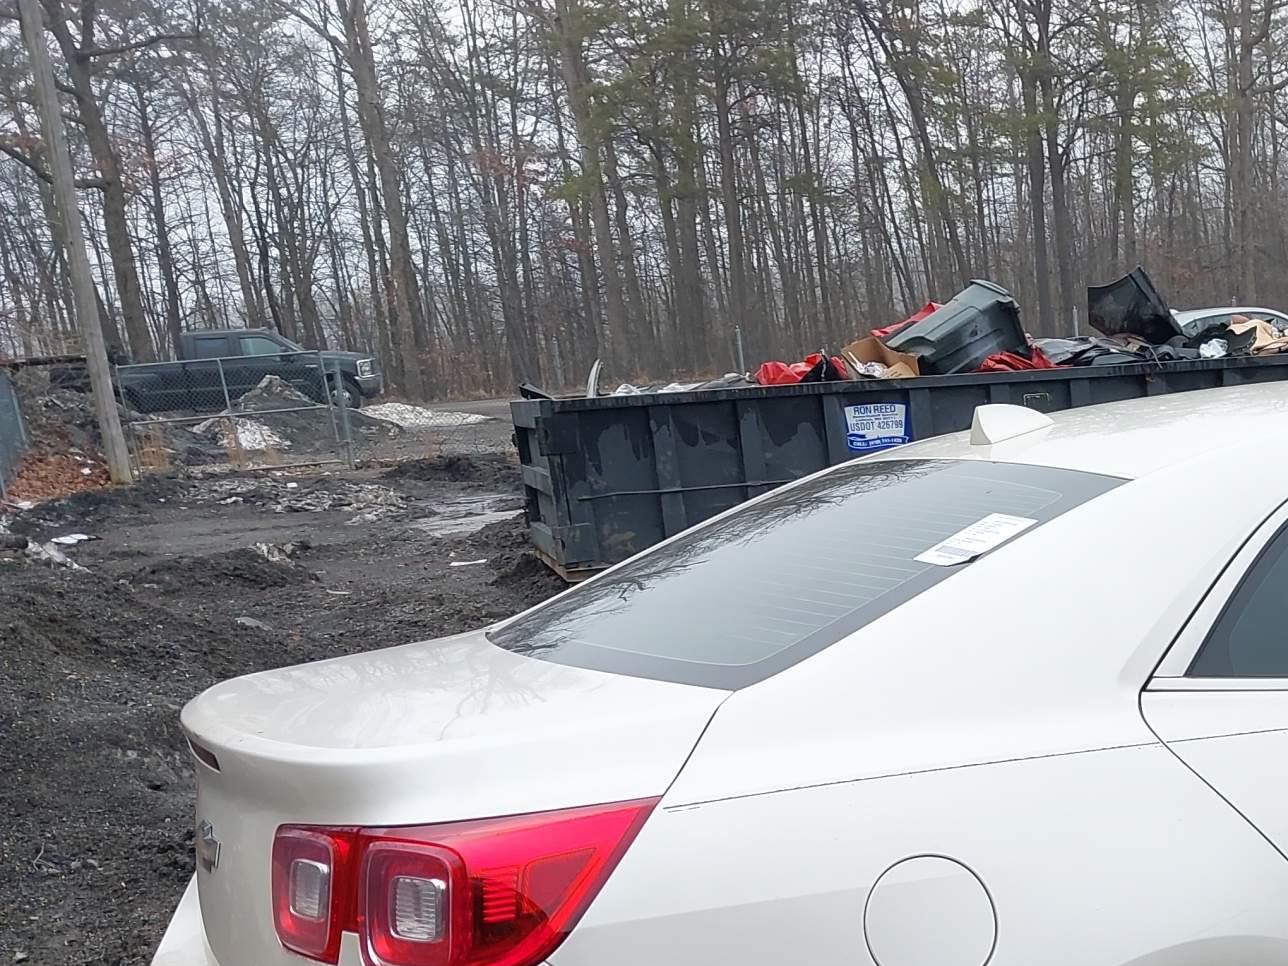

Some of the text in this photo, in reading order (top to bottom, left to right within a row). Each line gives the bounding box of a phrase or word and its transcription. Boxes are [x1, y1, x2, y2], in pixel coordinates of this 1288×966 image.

[853, 404, 896, 415] RON REED
[850, 422, 875, 432] USDOT
